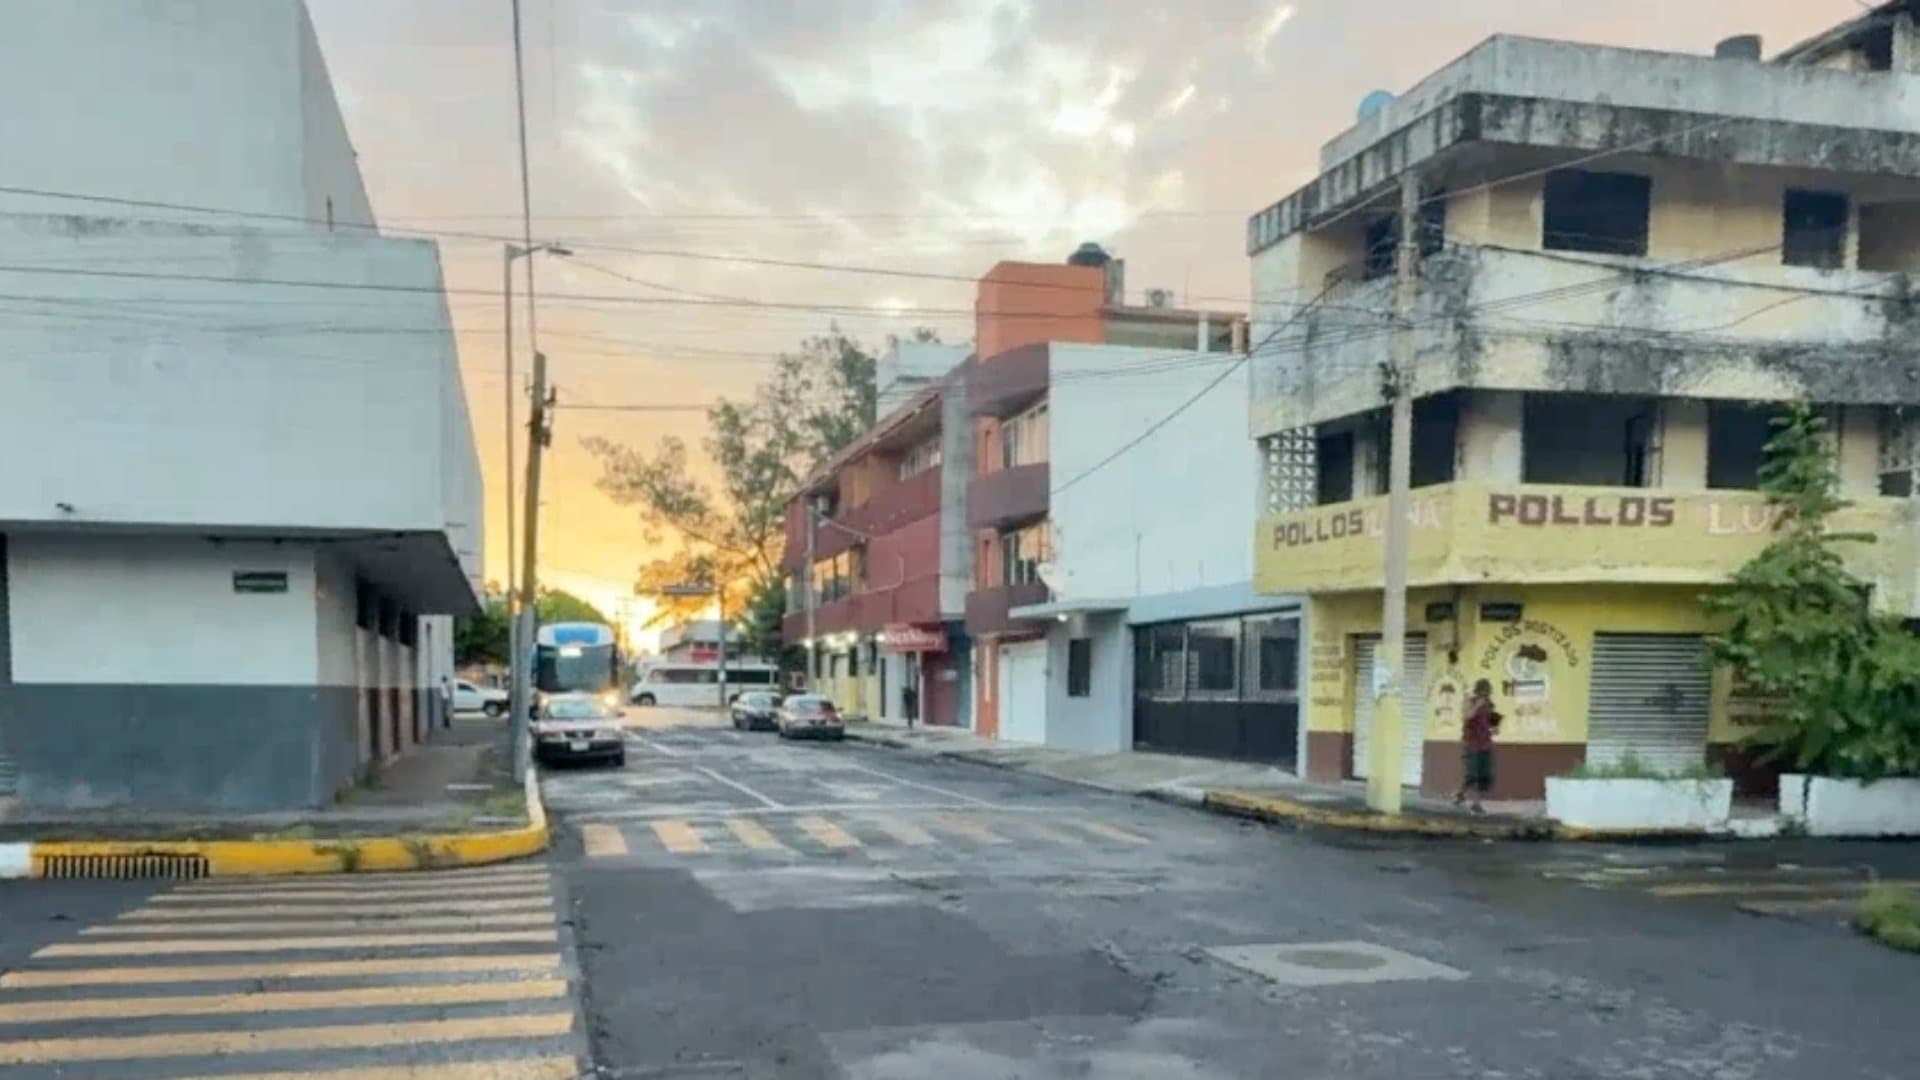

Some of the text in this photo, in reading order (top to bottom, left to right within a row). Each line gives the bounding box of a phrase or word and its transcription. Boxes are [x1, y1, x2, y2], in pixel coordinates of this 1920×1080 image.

[1273, 509, 1363, 550] POLLOS
[1488, 493, 1675, 527] POLLOS
[1480, 620, 1521, 670] POLLOS
